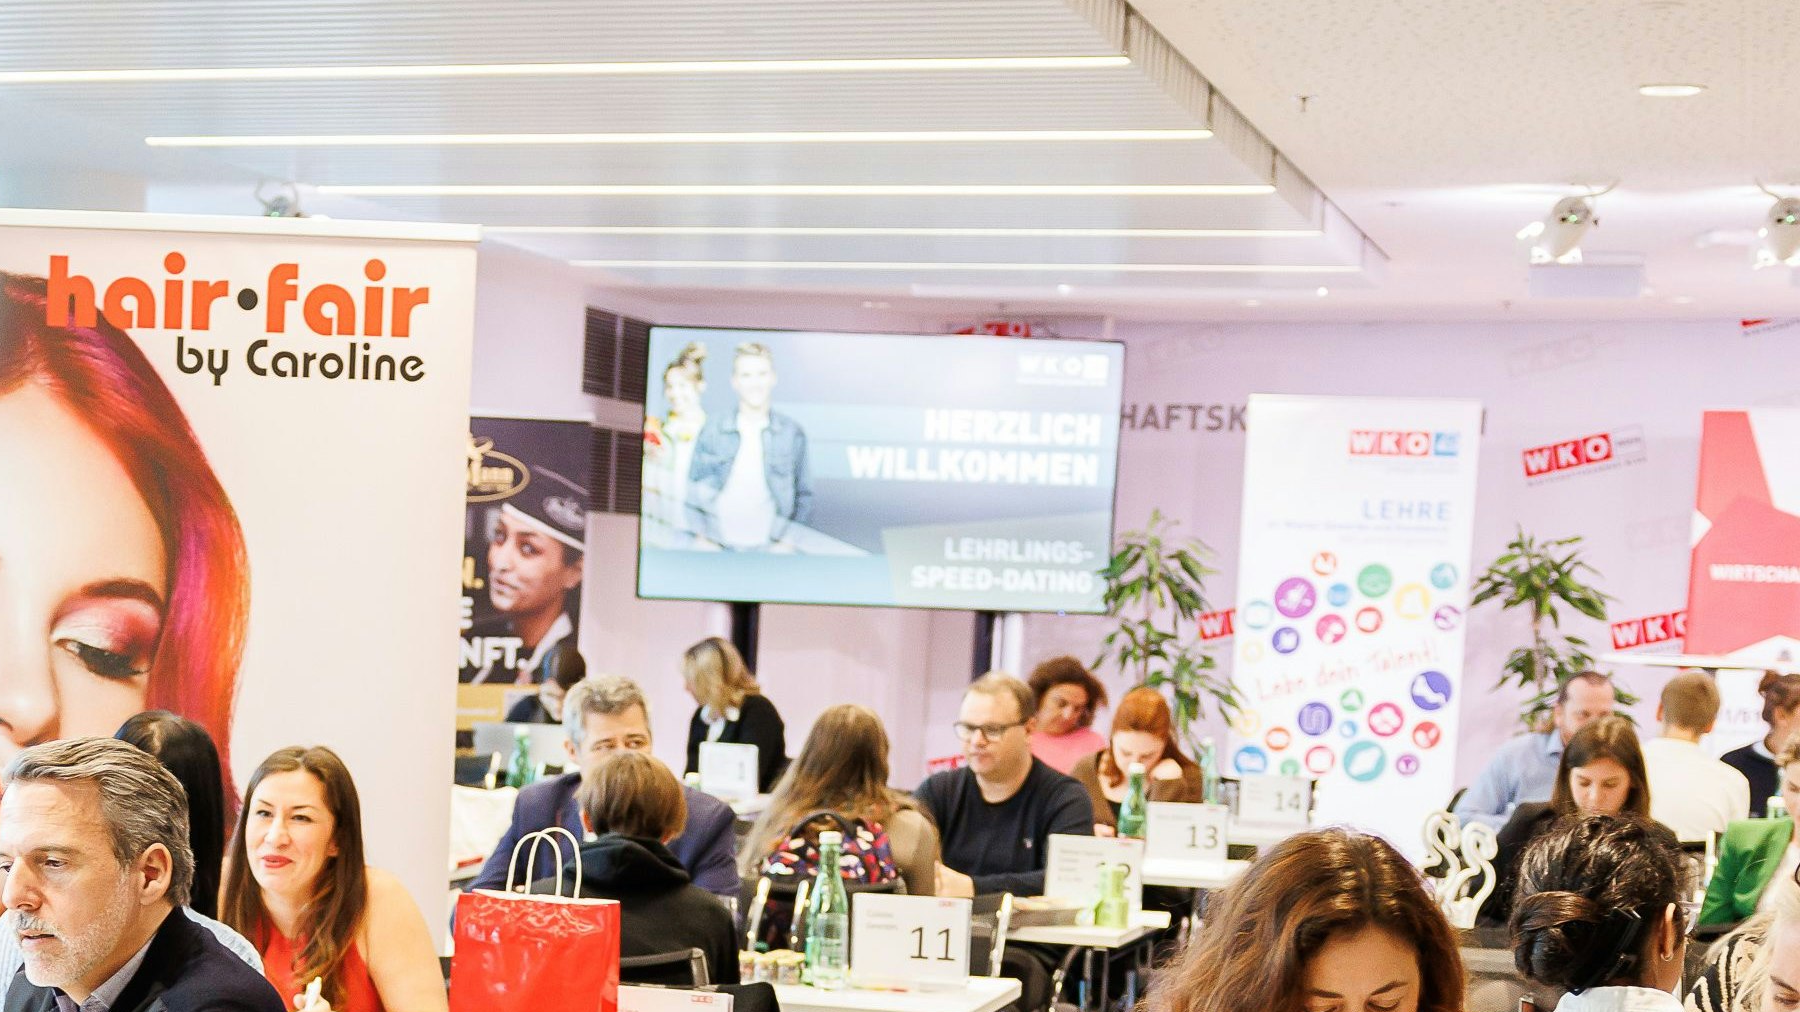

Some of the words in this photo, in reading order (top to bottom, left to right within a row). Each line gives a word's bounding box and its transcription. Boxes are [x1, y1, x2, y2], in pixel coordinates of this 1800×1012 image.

[176, 335, 230, 386] by
[246, 339, 426, 383] Caroline
[924, 407, 1101, 445] HERZLICH
[1350, 431, 1431, 456] WKO
[1524, 433, 1611, 475] WKO
[847, 445, 1099, 486] WILLKOMMEN
[1361, 500, 1451, 521] LEHRE
[944, 536, 1095, 564] LEHRLINGS-
[911, 566, 1093, 594] SPEED-DATING
[1276, 792, 1301, 812] 14
[1187, 826, 1219, 850] 13
[910, 926, 956, 962] 11
